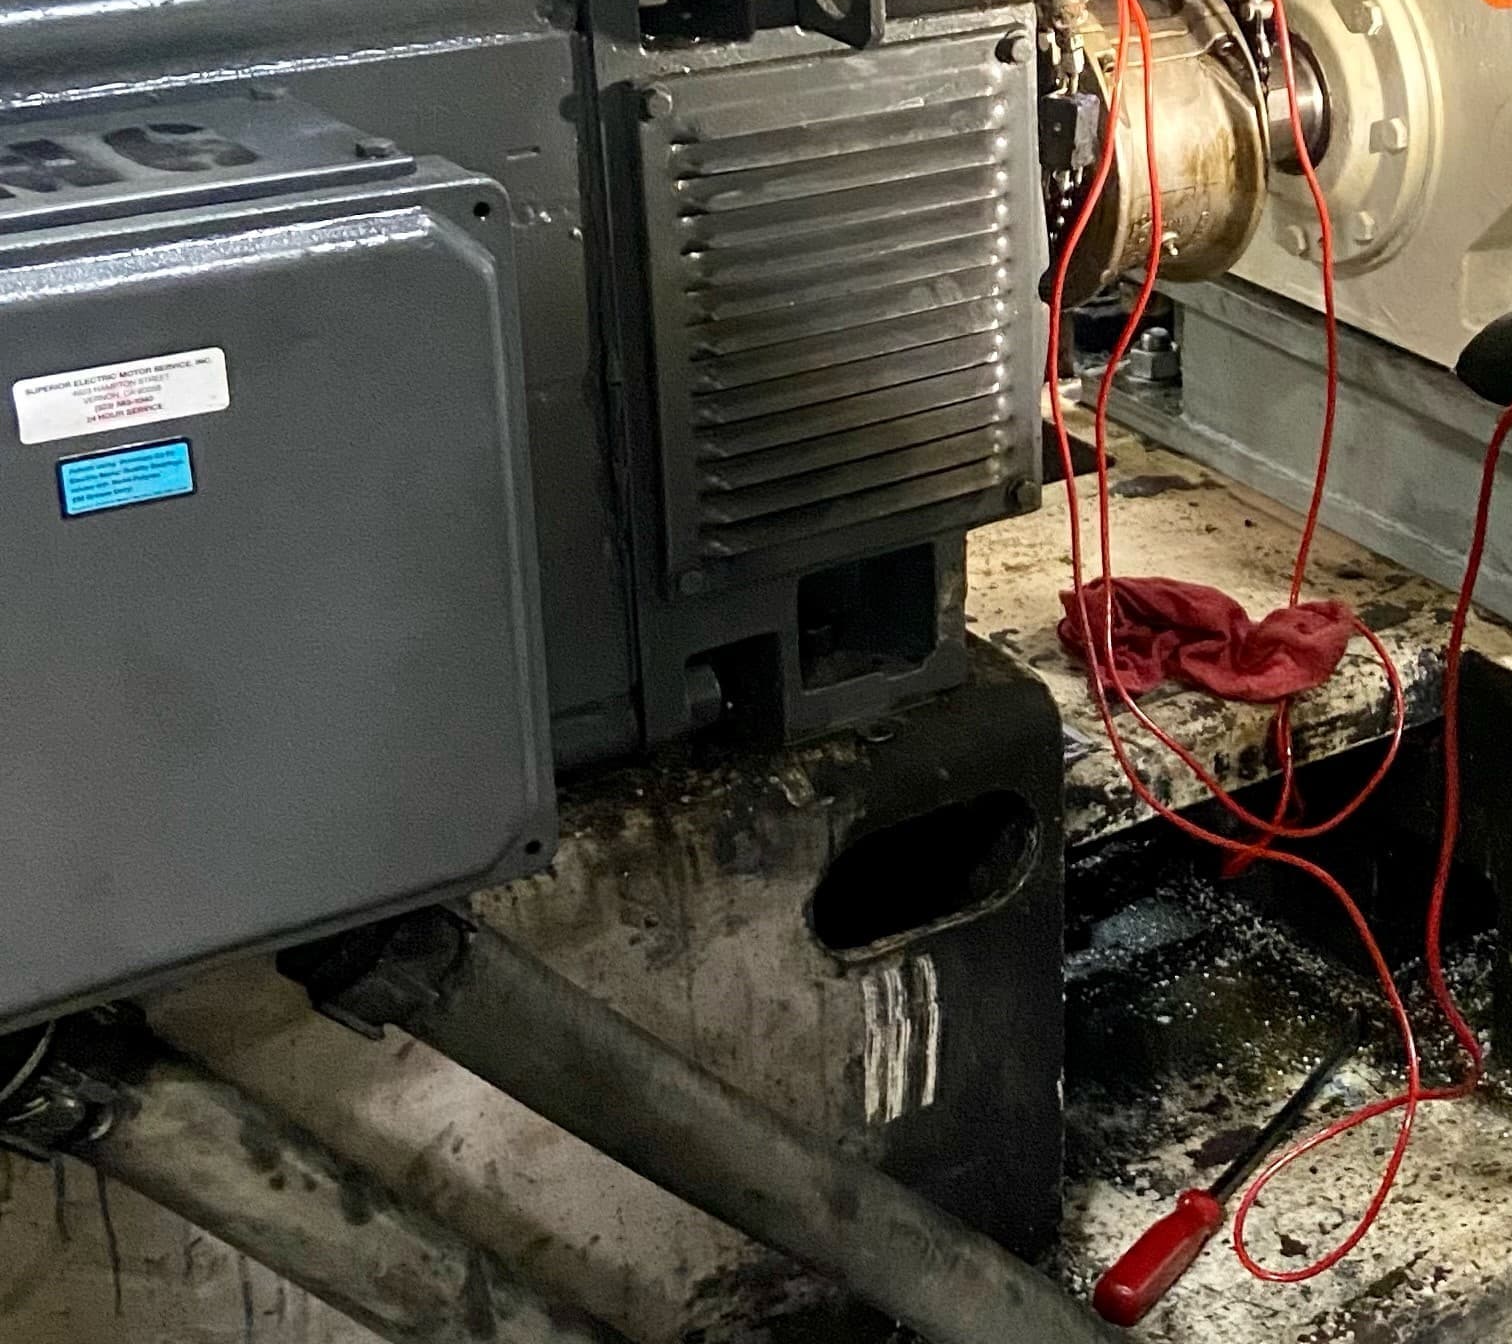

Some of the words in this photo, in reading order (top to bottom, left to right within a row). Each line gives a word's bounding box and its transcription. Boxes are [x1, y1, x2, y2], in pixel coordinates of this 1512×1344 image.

[25, 381, 71, 395] SUPERIOR
[73, 373, 117, 387] ELECTRIC
[119, 367, 151, 378] MOTOR
[138, 372, 169, 384] STREET
[98, 409, 125, 419] HOUR
[125, 403, 162, 415] SERVICE
